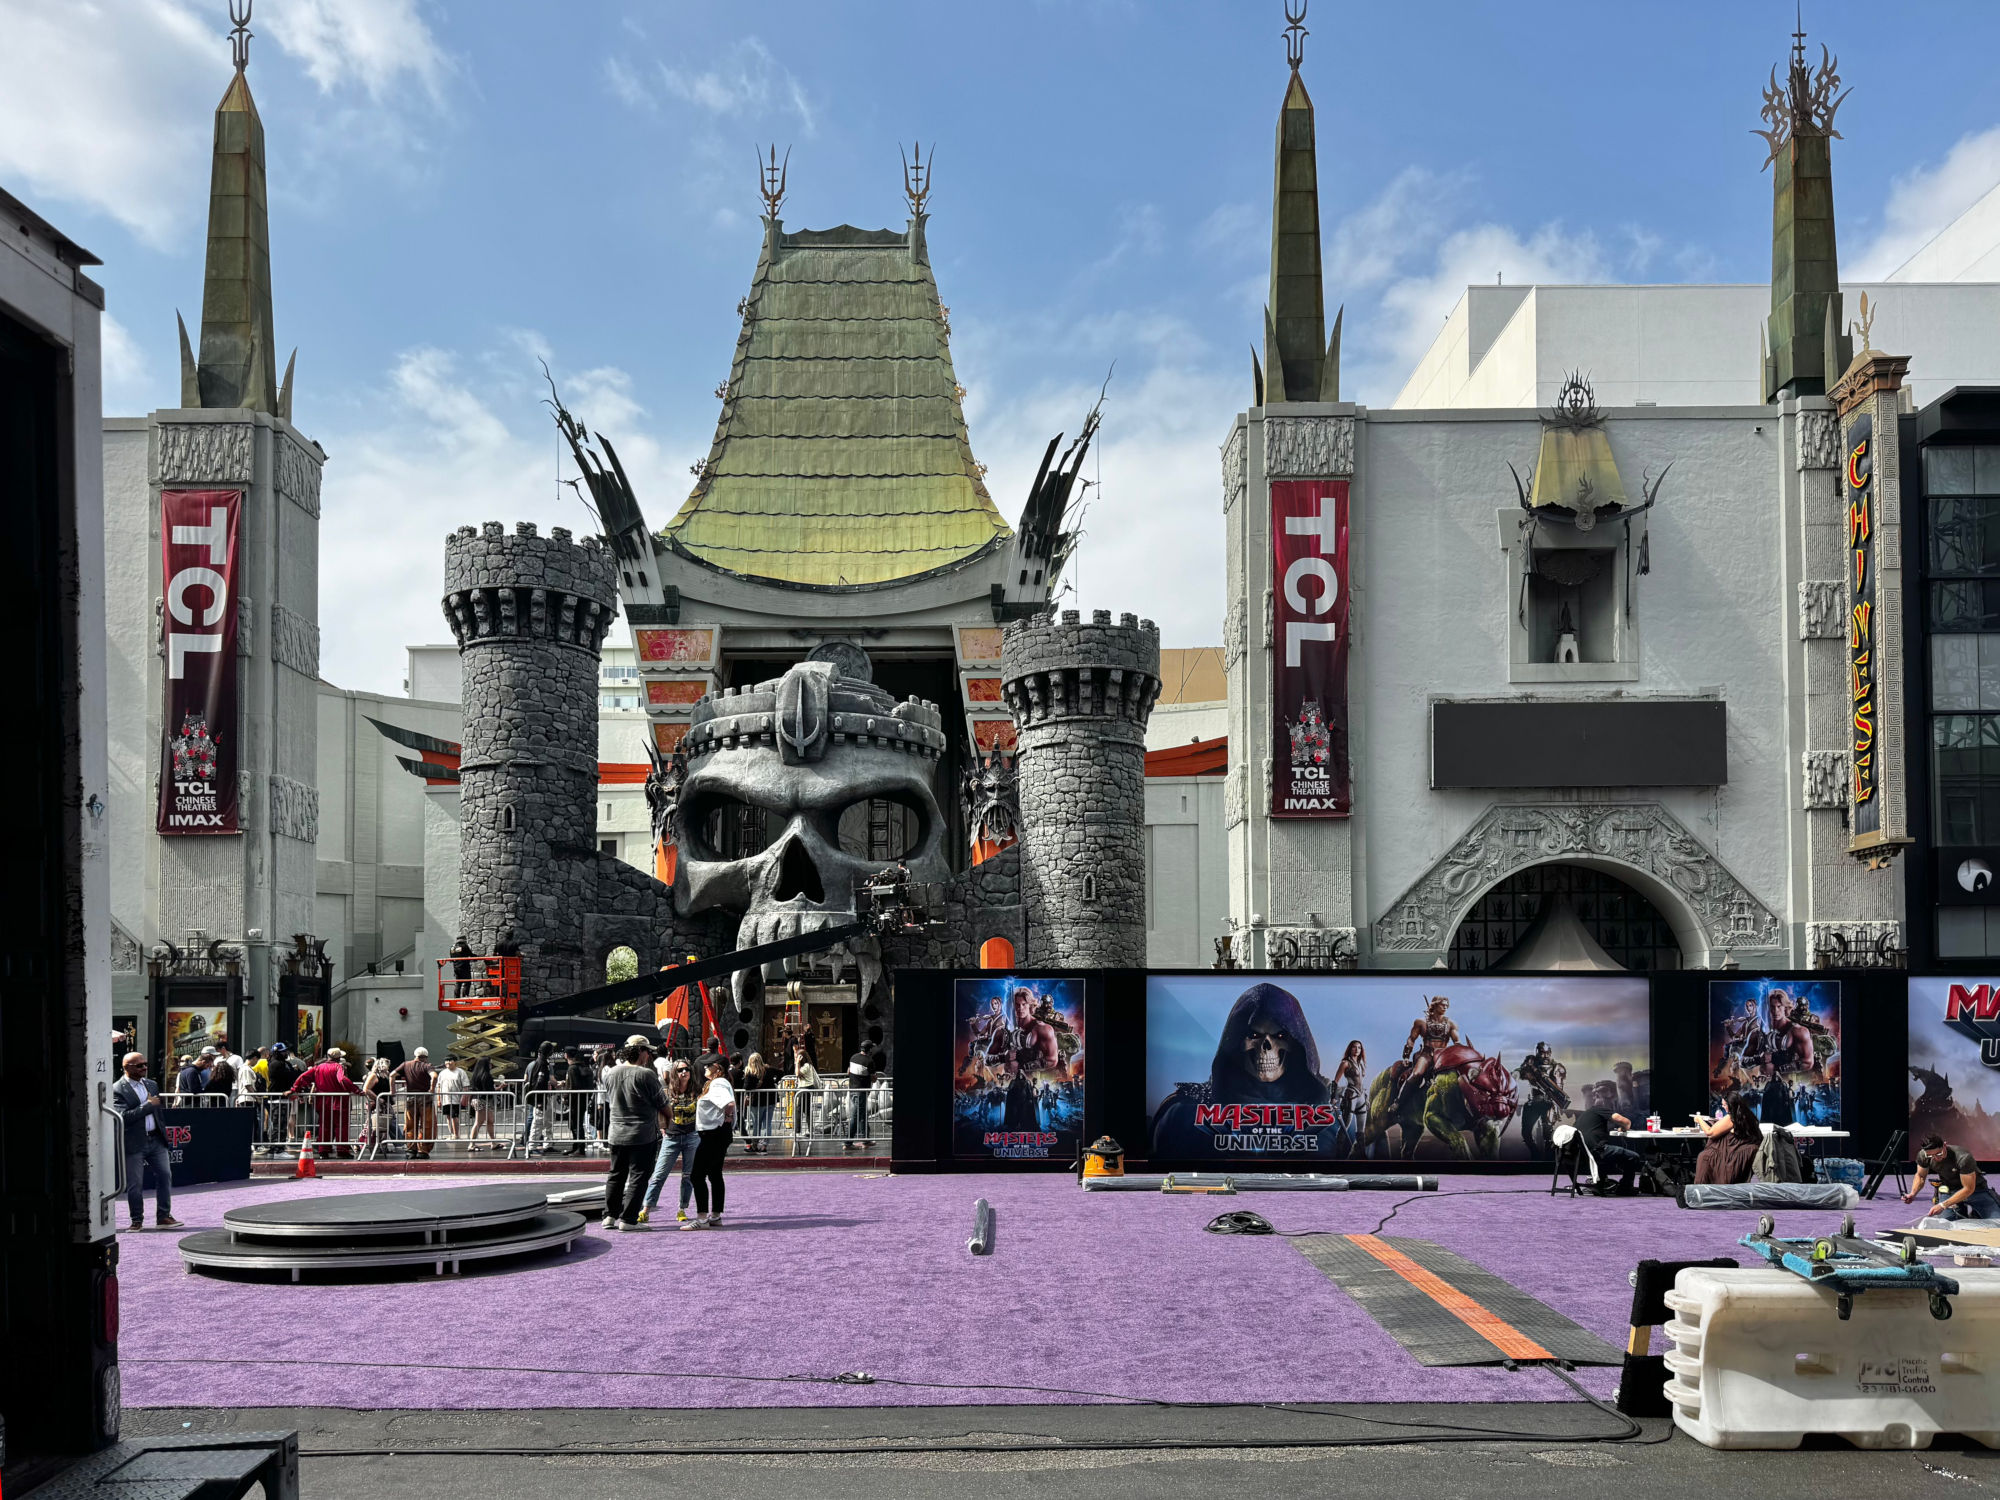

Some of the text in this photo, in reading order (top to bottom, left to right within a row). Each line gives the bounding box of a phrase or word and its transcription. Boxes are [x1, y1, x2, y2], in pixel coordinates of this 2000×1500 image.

[1283, 497, 1338, 668] TCL
[168, 506, 227, 680] TCL
[1848, 439, 1873, 804] CHINESE
[1291, 767, 1330, 779] TCL
[174, 781, 217, 795] TCL
[1291, 780, 1330, 789] CHINESE
[1291, 788, 1330, 796] THEATRES
[175, 796, 216, 805] CHINESE
[1284, 798, 1337, 810] IMAX
[169, 814, 224, 826] IMAX
[97, 1059, 106, 1073] 21
[1194, 1103, 1336, 1131] MASTERS
[165, 1125, 192, 1148] ERS
[983, 1132, 1058, 1147] MASTERS
[1214, 1134, 1319, 1153] UNIVERSE
[993, 1148, 1049, 1158] UNIVERSE
[1902, 1375, 1930, 1384] Control
